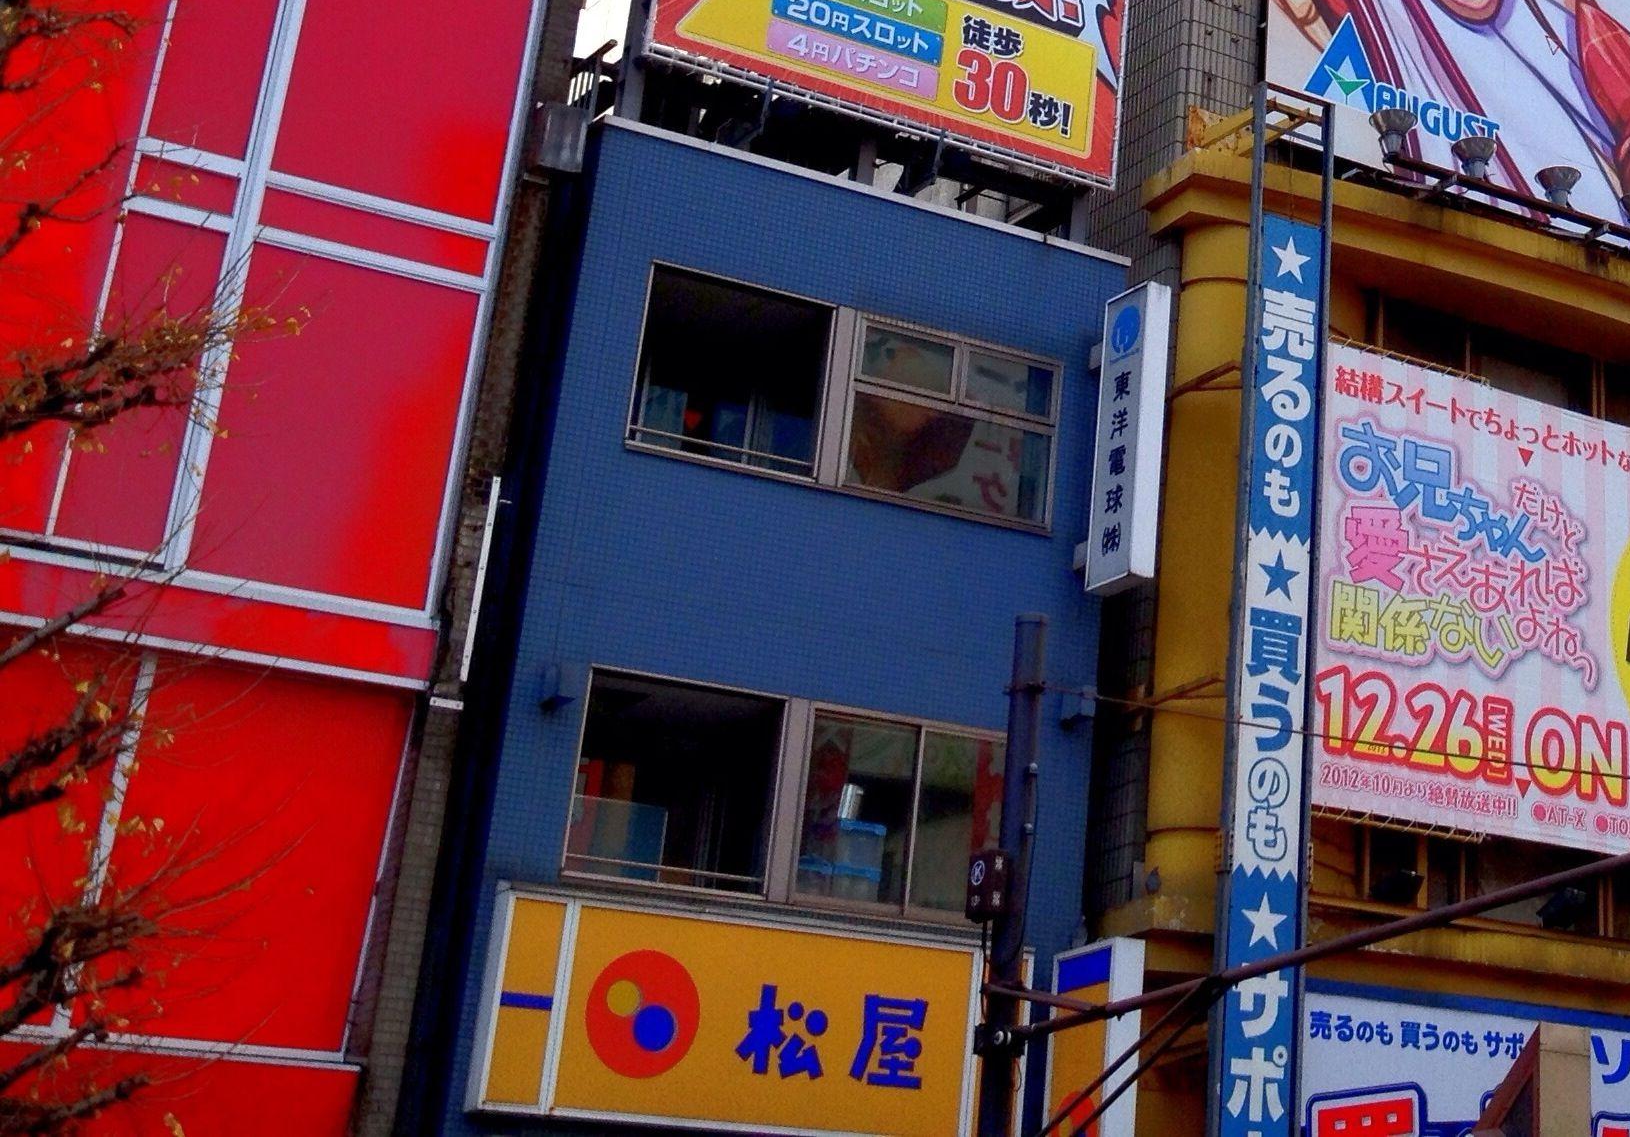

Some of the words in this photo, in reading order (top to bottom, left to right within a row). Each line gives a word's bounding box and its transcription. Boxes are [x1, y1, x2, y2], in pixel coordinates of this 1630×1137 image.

[786, 29, 920, 89] 4円パチンコ
[961, 14, 1023, 58] 徒歩
[1260, 286, 1317, 519] 売るのも
[1244, 606, 1304, 863] 買うのも
[1524, 708, 1628, 806] ON
[1547, 803, 1586, 831] AT-X
[735, 984, 928, 1090] 松屋
[1226, 962, 1290, 1137] サポ
[1309, 1010, 1395, 1046] 売るのも
[1399, 1019, 1480, 1056] 買うのも
